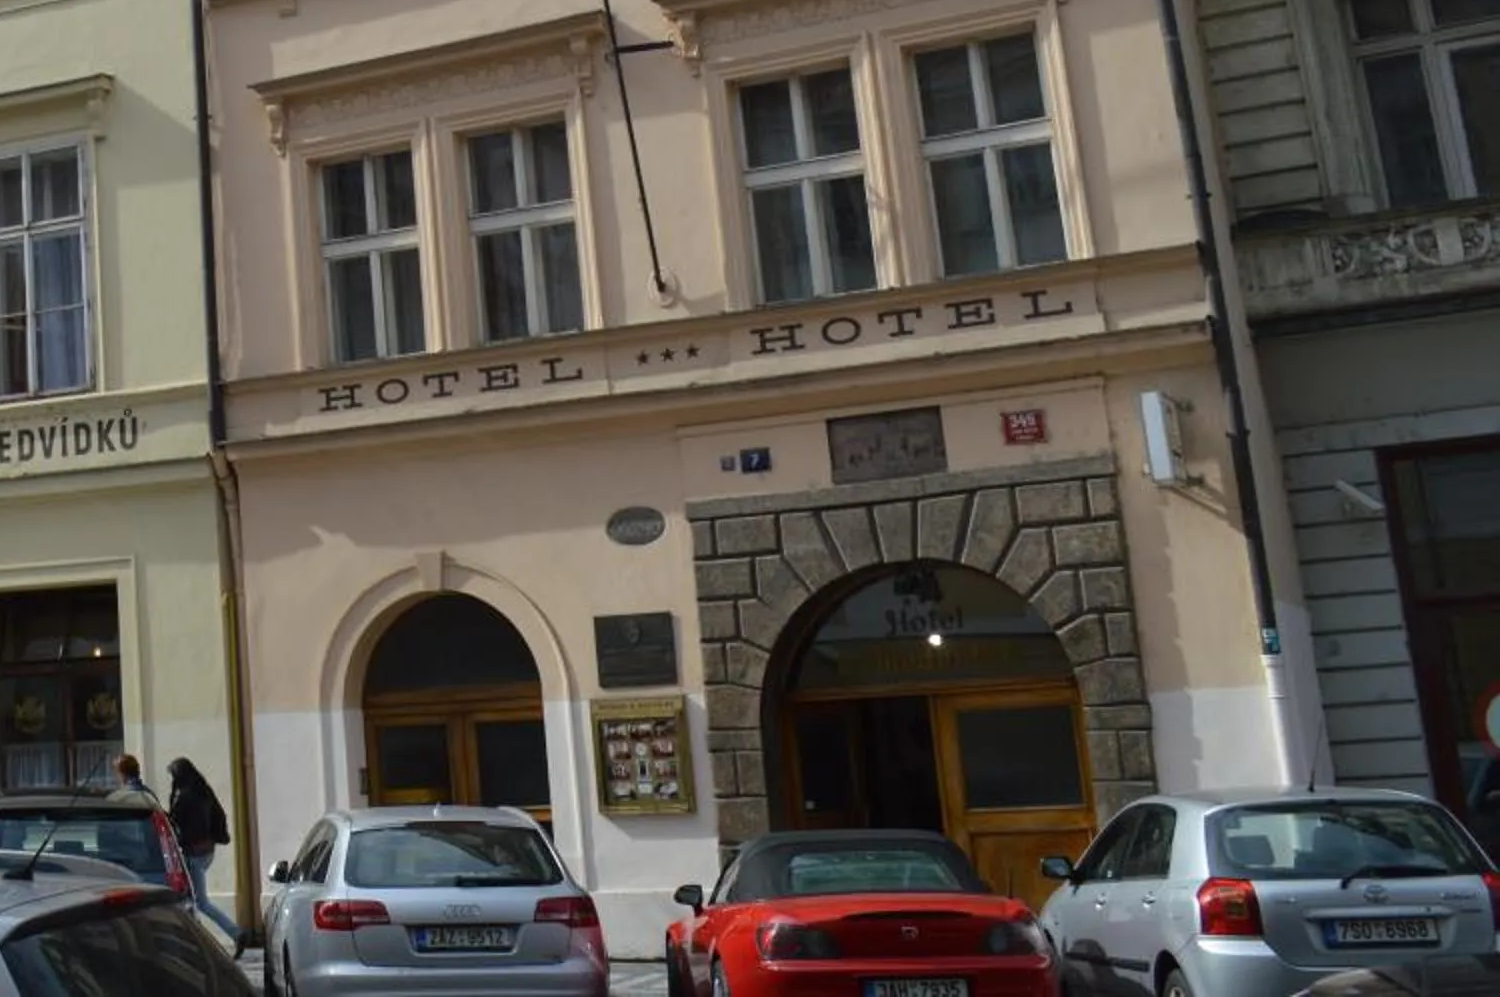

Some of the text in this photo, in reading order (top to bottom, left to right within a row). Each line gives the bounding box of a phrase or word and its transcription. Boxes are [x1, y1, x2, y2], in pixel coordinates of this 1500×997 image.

[751, 290, 1074, 356] HOTEL
[319, 356, 585, 413] HOTEL
[885, 607, 964, 636] Hotel
